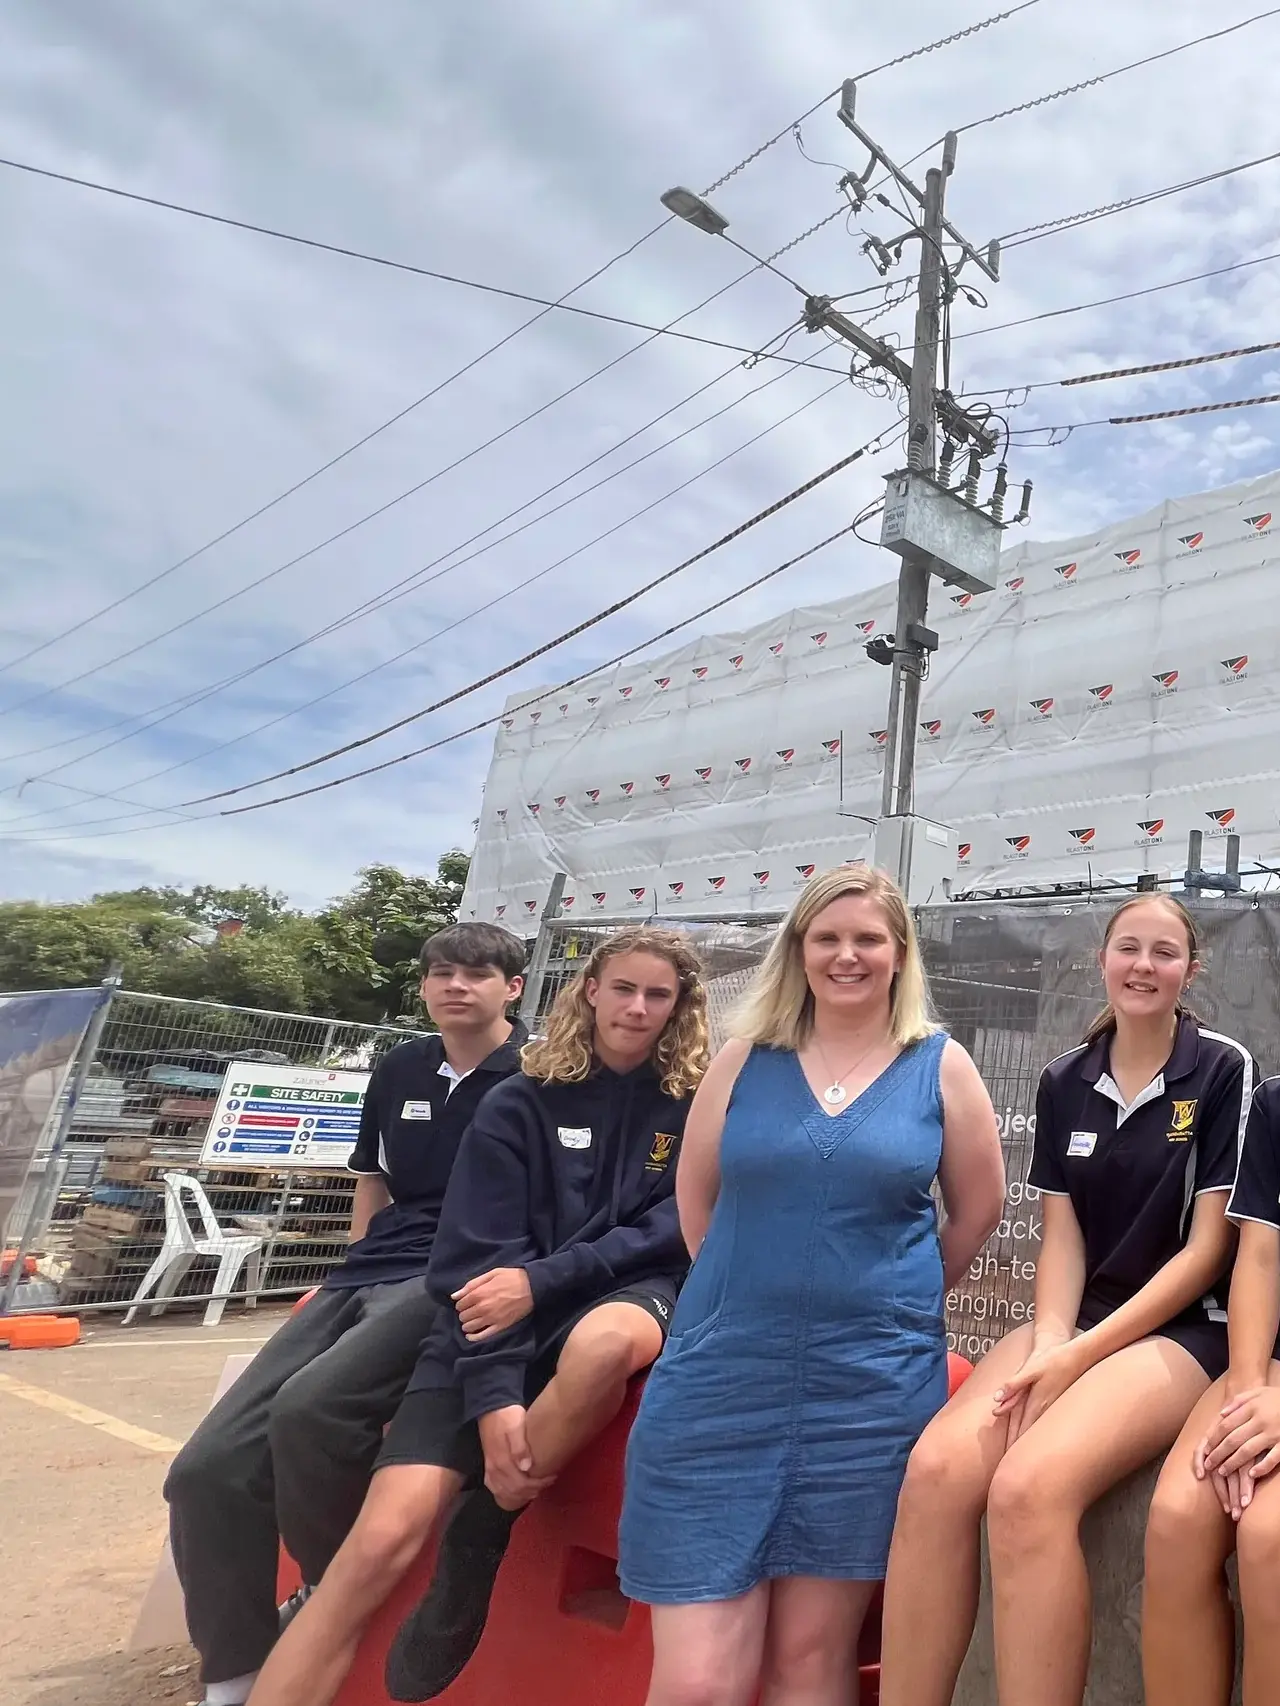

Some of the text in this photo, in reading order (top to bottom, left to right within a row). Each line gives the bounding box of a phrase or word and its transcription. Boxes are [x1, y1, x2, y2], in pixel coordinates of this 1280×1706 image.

[1219, 672, 1248, 684] BLASTONE
[1204, 827, 1235, 836] BLASTONE
[271, 1088, 345, 1102] SITE SAFETY
[994, 1106, 1037, 1138] ojec
[1008, 1181, 1040, 1206] ga
[993, 1214, 1042, 1240] ack
[970, 1250, 1036, 1280] gh-te
[946, 1291, 1036, 1321] enginee
